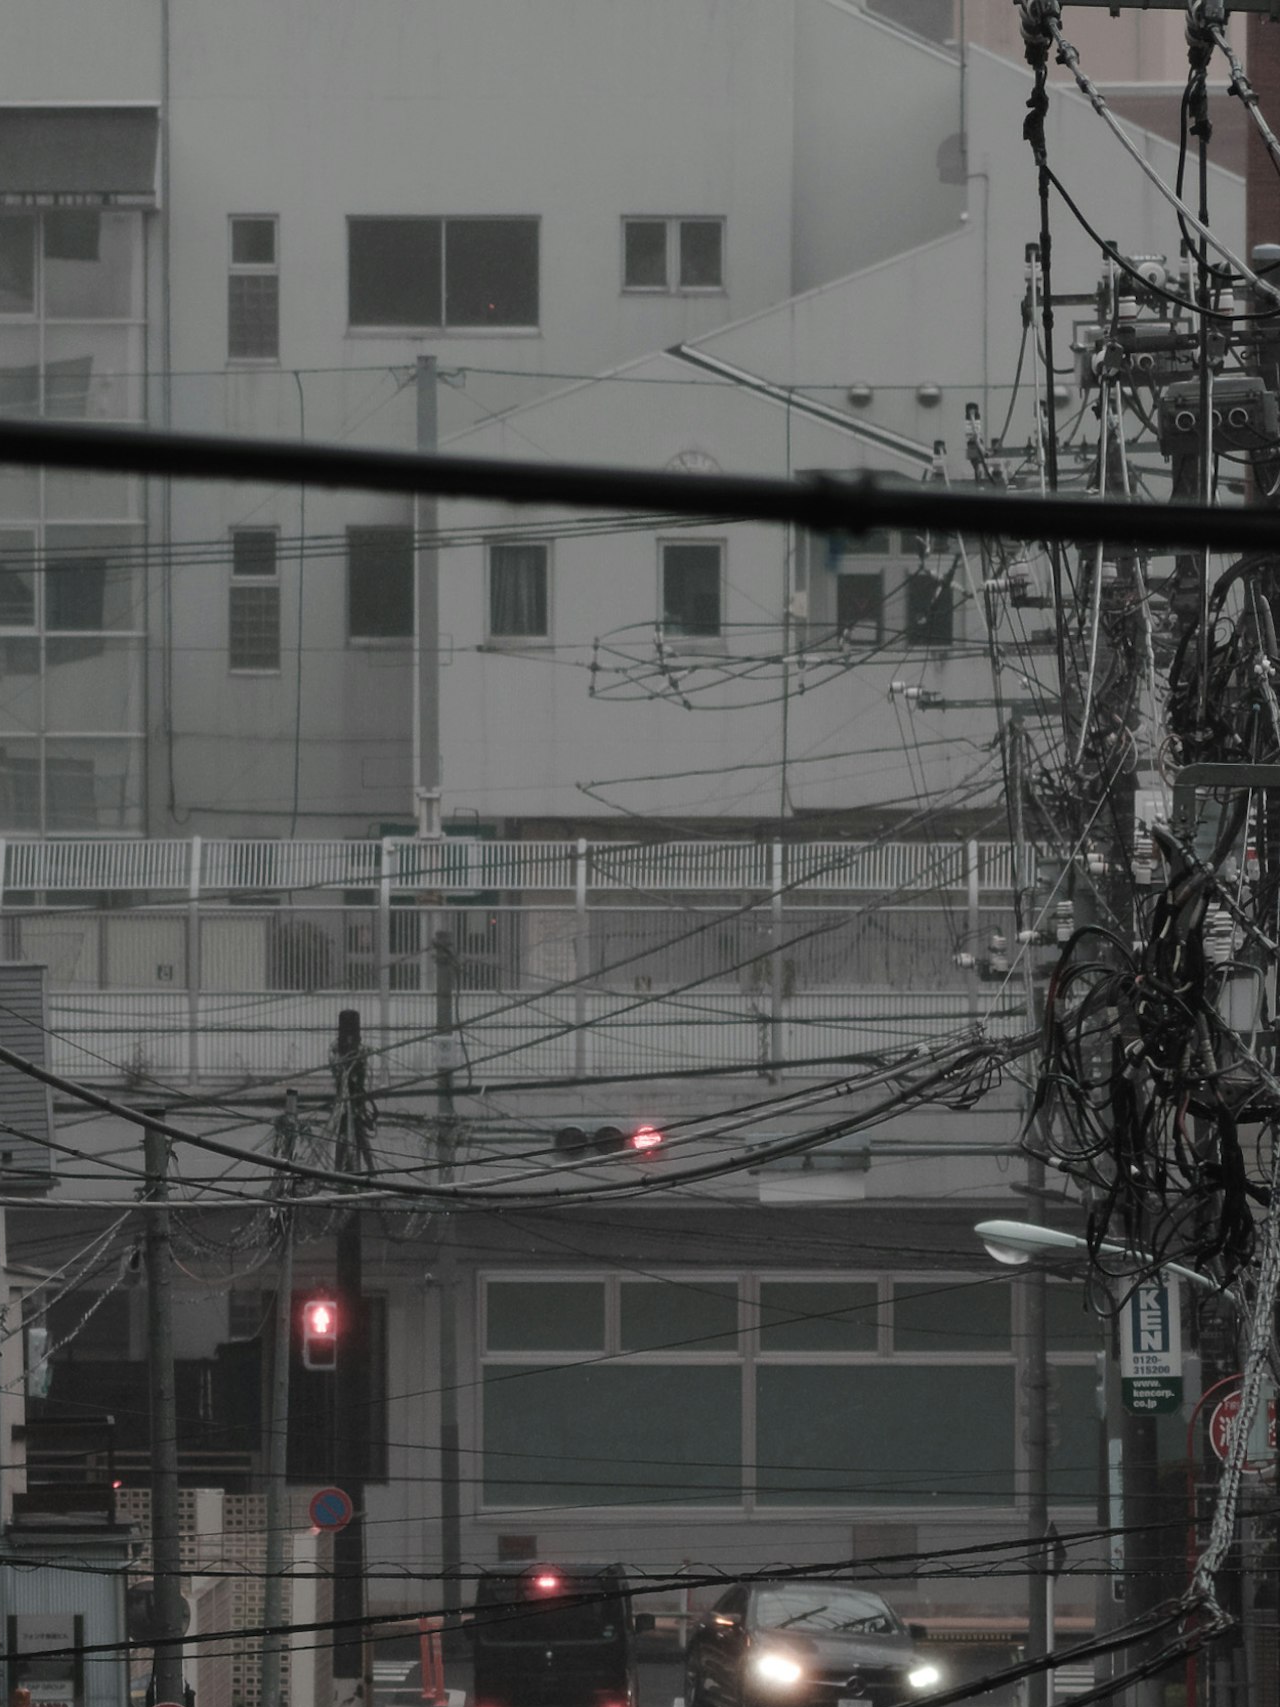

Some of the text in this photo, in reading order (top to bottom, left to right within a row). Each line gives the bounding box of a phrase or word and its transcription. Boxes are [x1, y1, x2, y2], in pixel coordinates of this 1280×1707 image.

[1139, 1290, 1163, 1351] KEN
[1133, 1380, 1161, 1389] www.
[1133, 1389, 1175, 1400] kencorp.
[1133, 1399, 1157, 1409] co.jp
